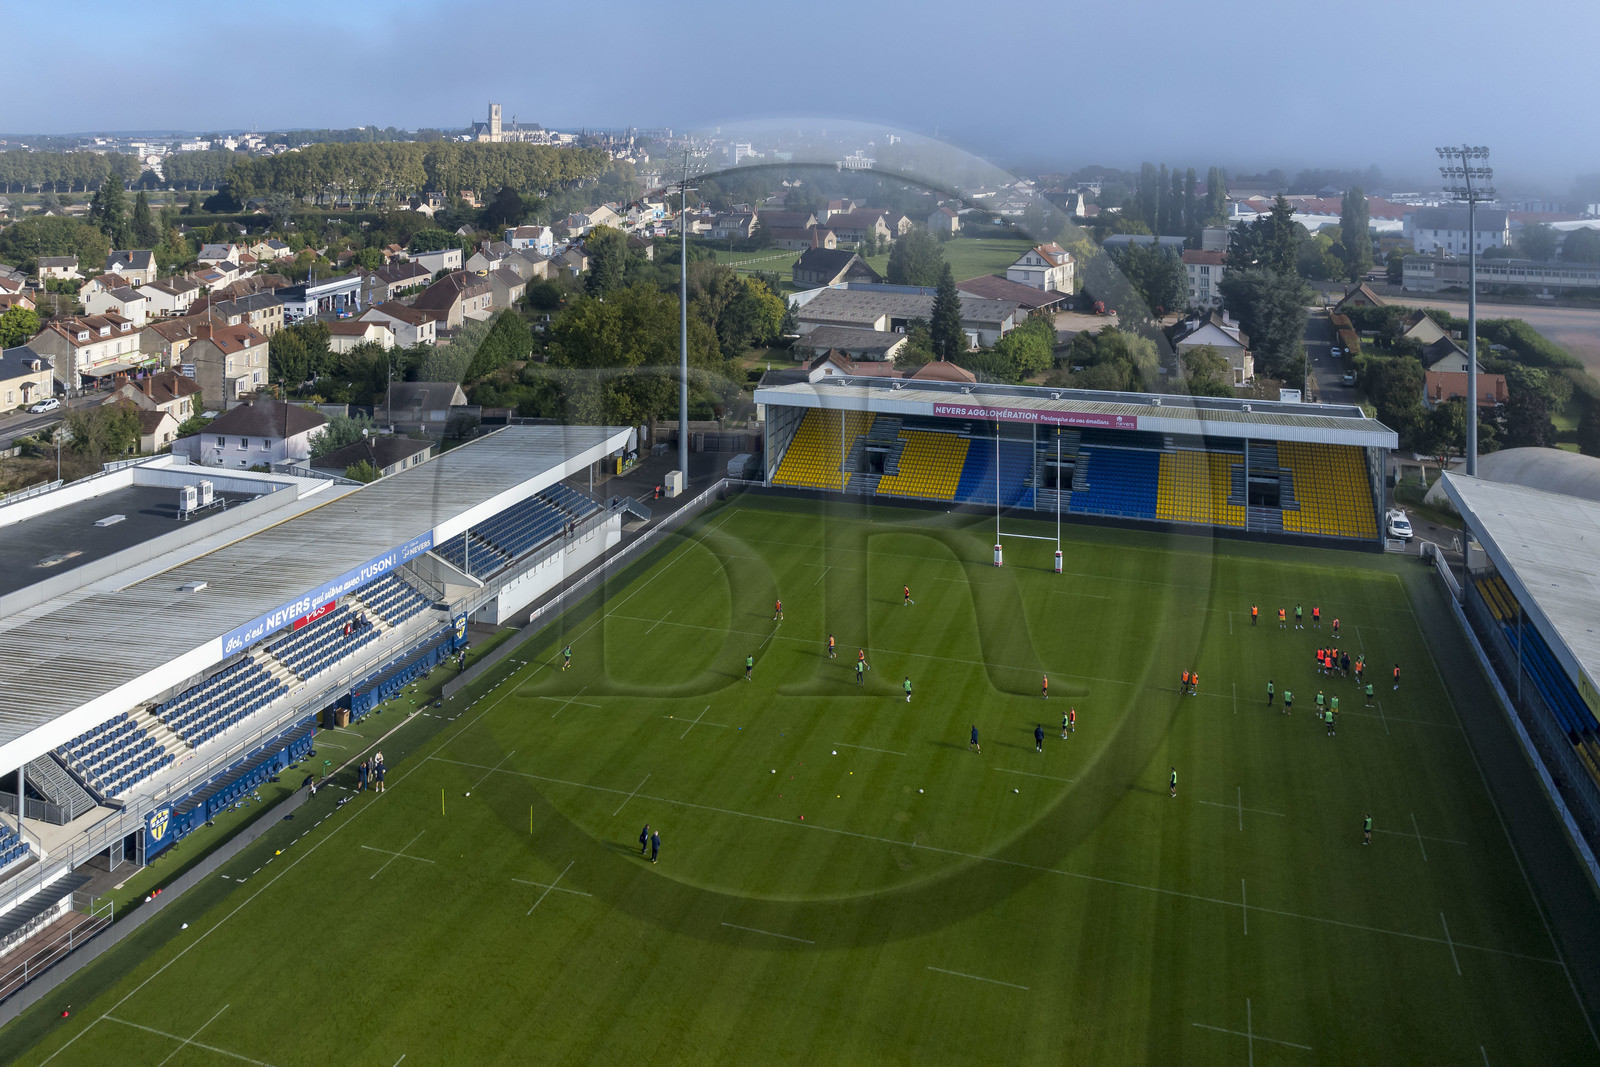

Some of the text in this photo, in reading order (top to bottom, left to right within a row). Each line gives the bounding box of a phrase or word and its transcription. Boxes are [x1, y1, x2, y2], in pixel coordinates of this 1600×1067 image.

[935, 406, 1038, 420] NEVERS AGGLOMÉRATION
[409, 539, 431, 556] NEVERS
[244, 623, 264, 642] c'est
[266, 597, 311, 631] NEVERS
[311, 592, 324, 610] qui
[324, 583, 343, 601] vibre
[343, 575, 360, 590] avec
[360, 555, 392, 581] l'USON
